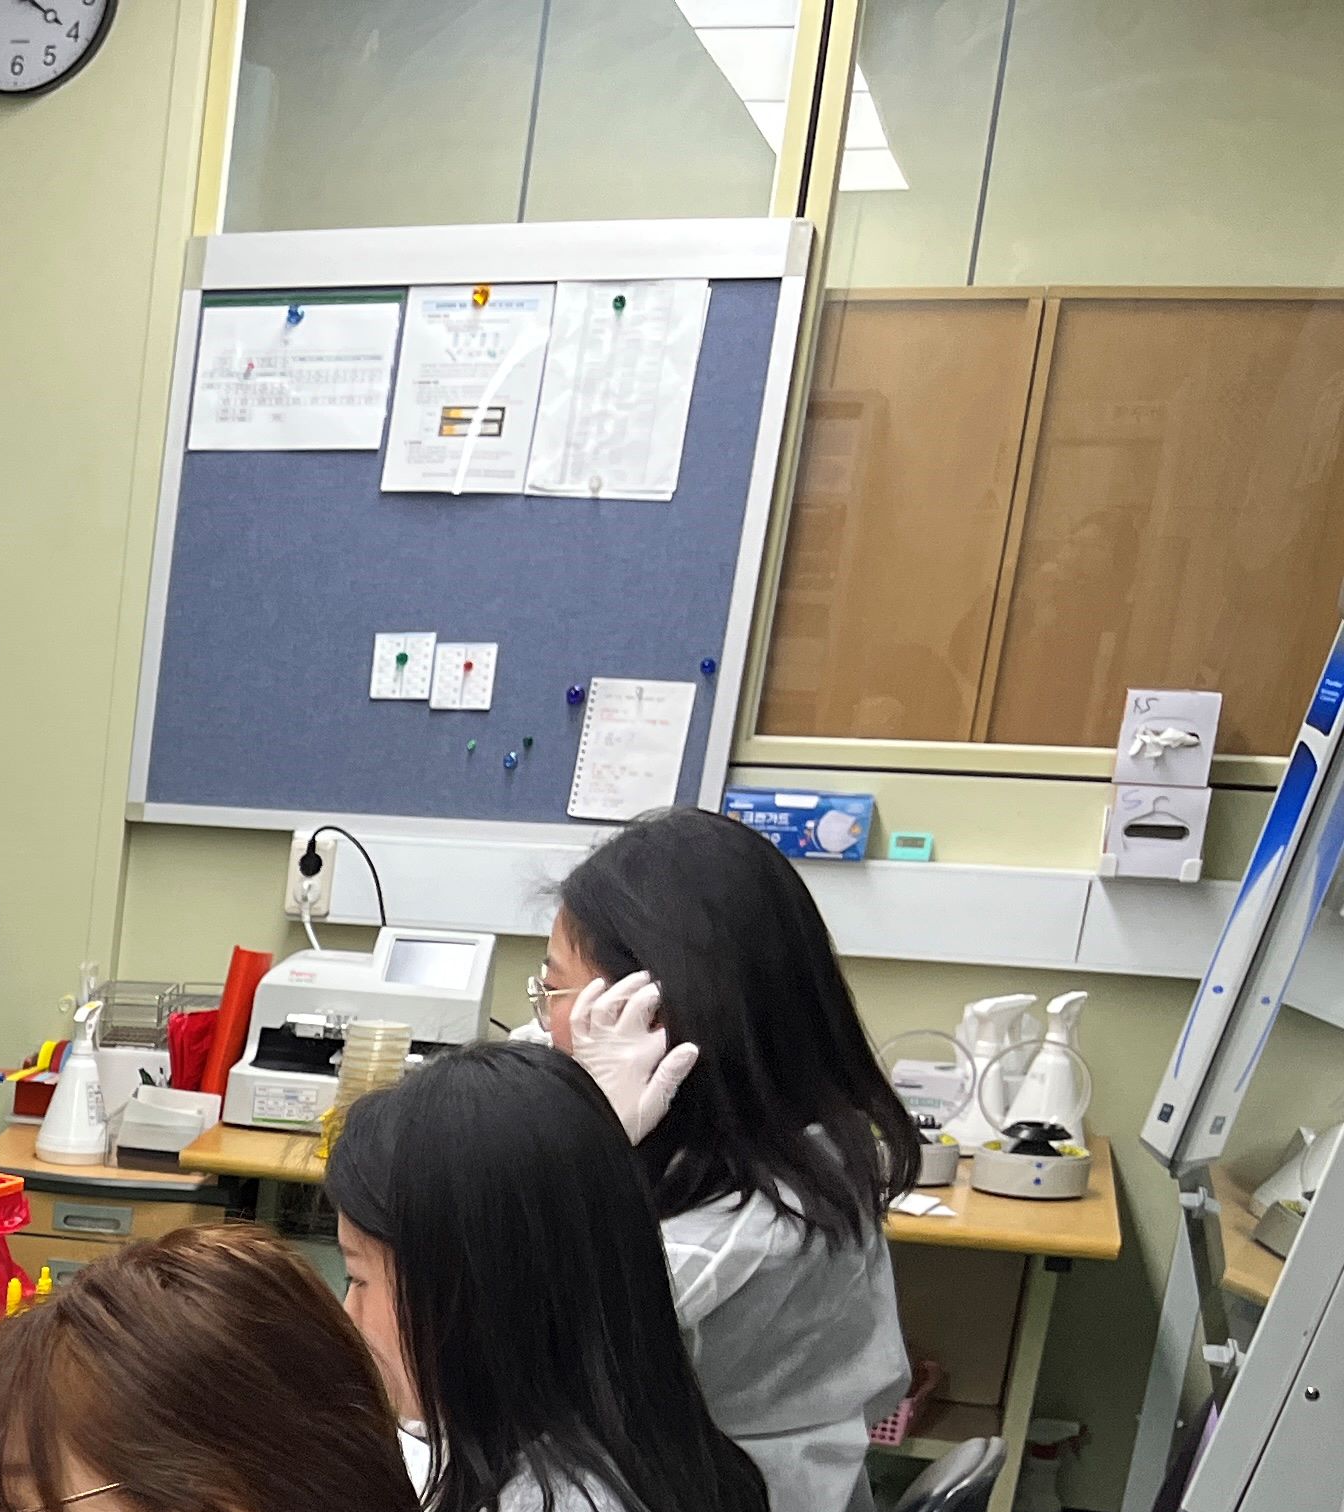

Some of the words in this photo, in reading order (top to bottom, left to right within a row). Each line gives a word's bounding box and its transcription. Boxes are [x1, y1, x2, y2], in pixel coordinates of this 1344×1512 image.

[66, 20, 80, 42] 4
[10, 55, 24, 75] 6
[43, 45, 57, 66] 5
